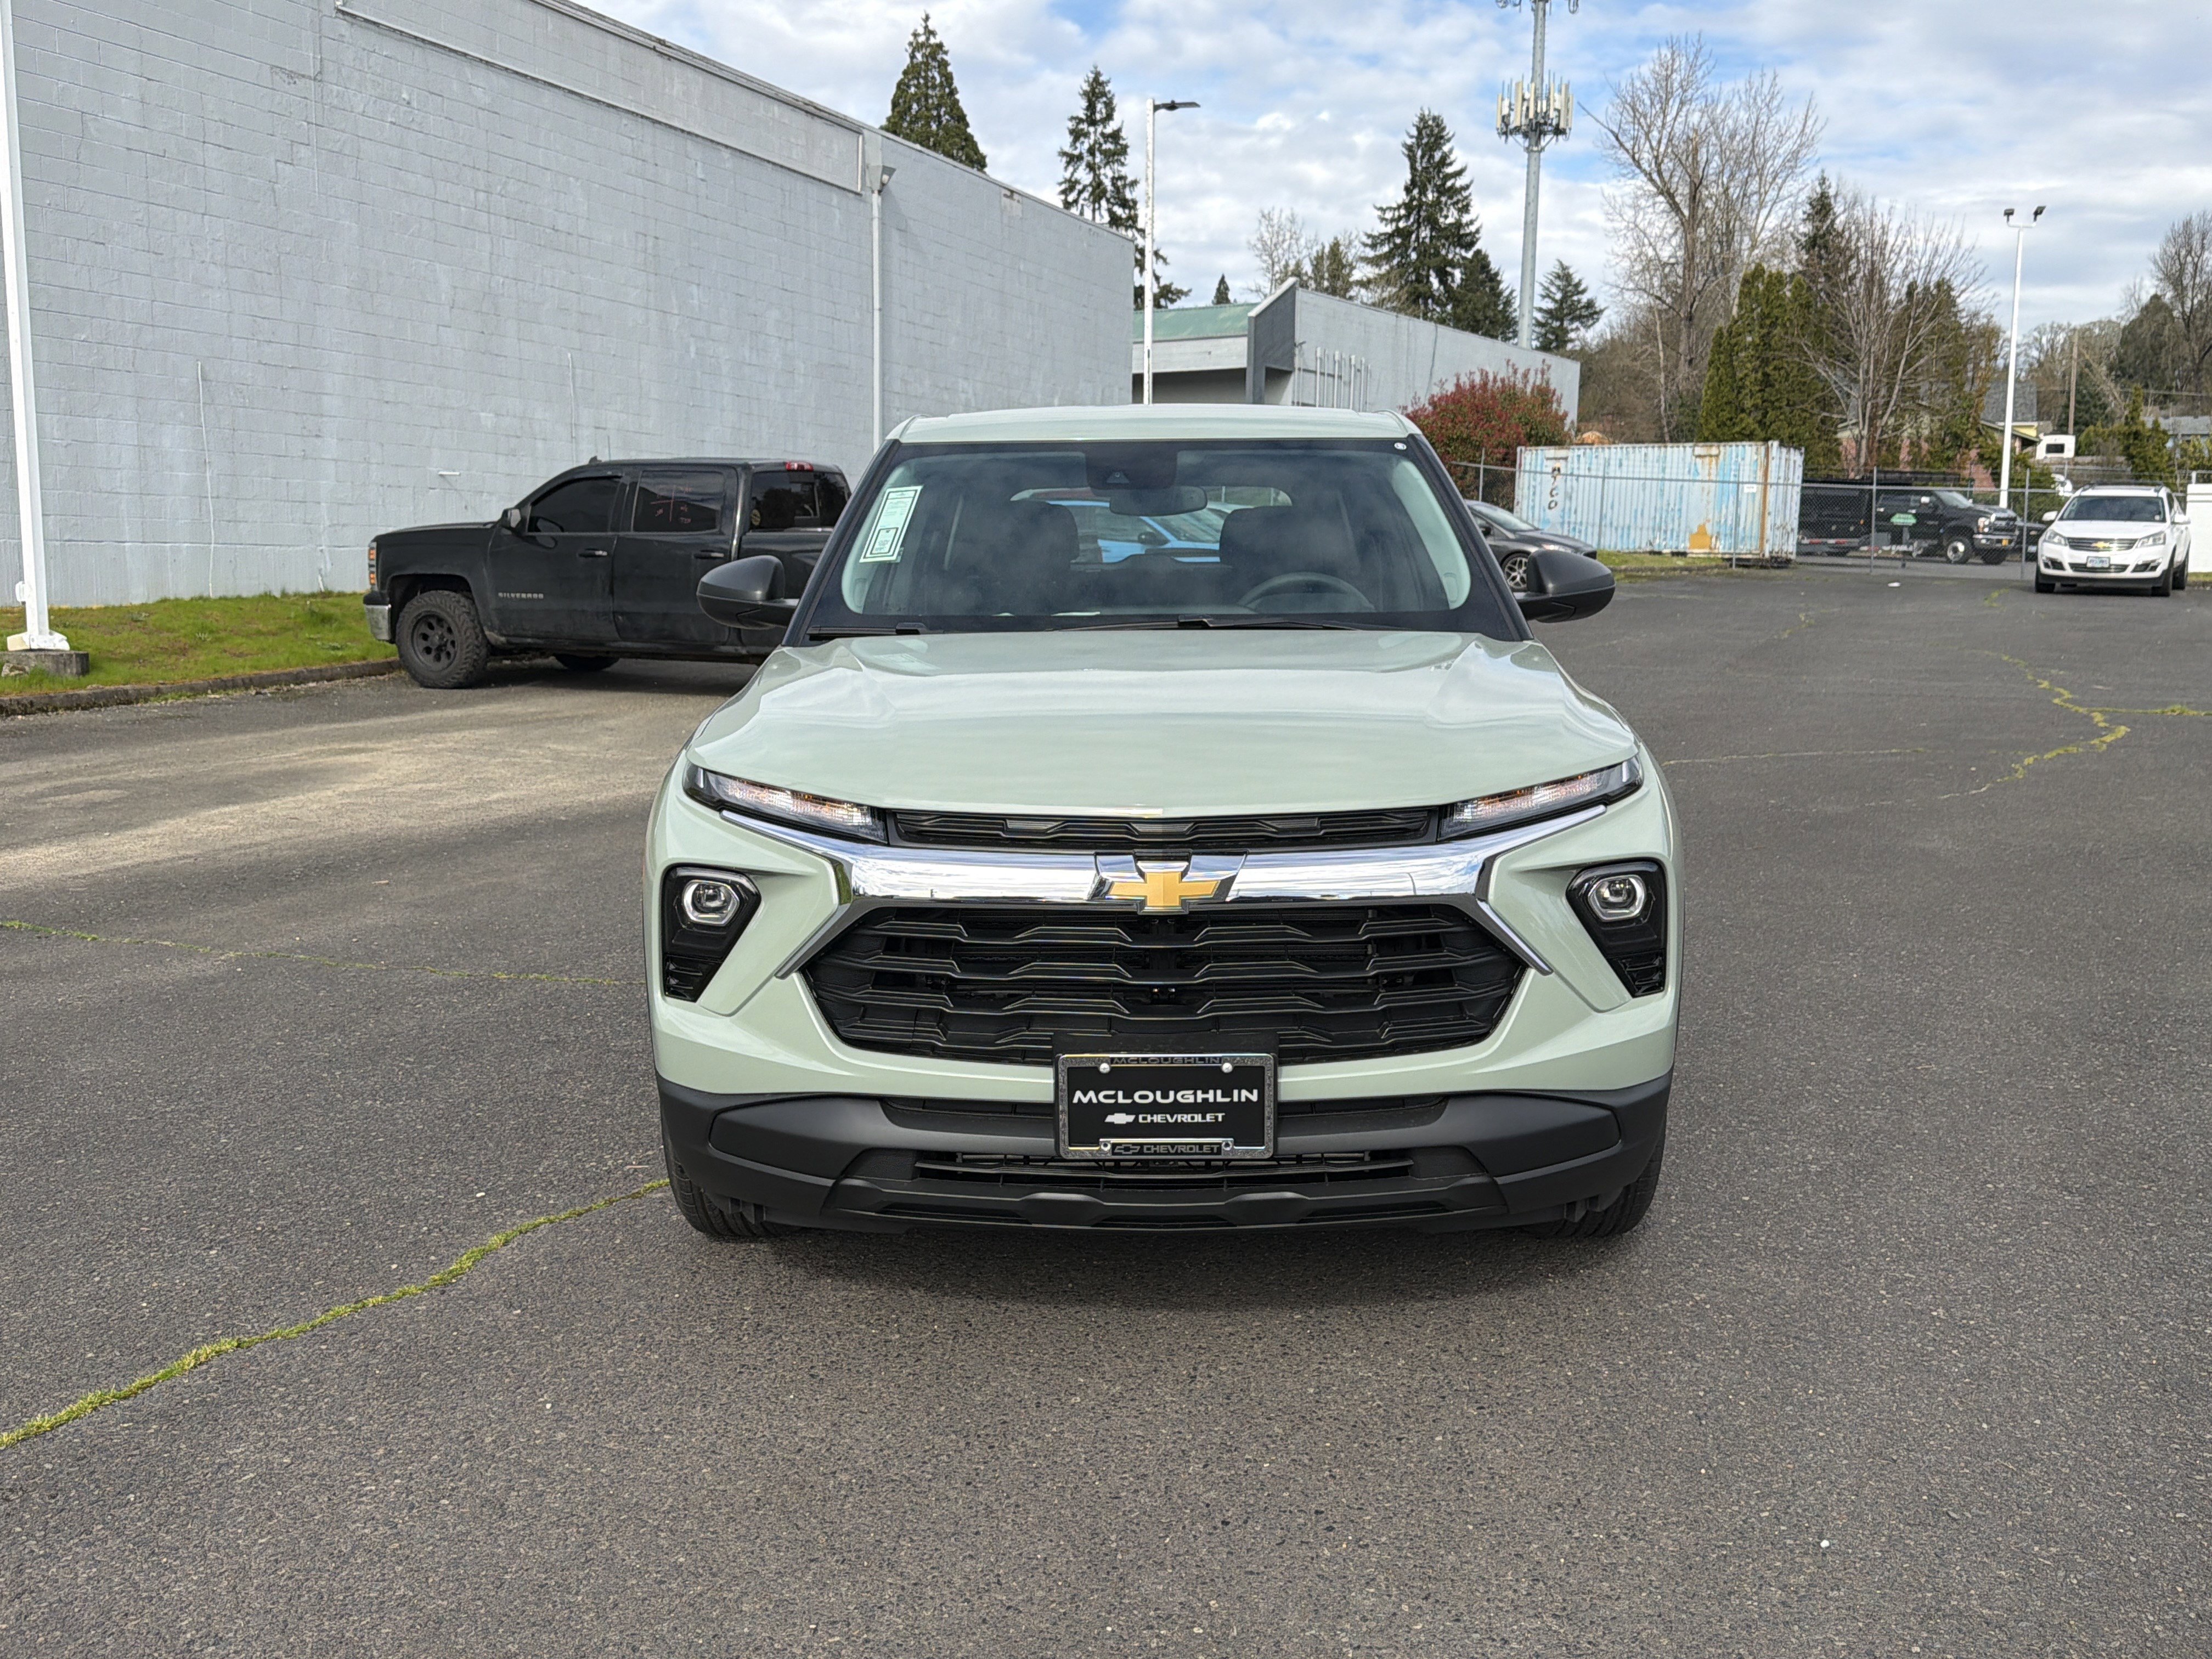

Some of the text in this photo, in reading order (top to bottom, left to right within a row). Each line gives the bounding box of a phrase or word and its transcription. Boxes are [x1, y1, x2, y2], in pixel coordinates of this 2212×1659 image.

[1072, 1089, 1259, 1104] MCLOUGHLIN
[1138, 1113, 1226, 1123] CHEVROLET
[1143, 1144, 1220, 1154] CHEVROLET
